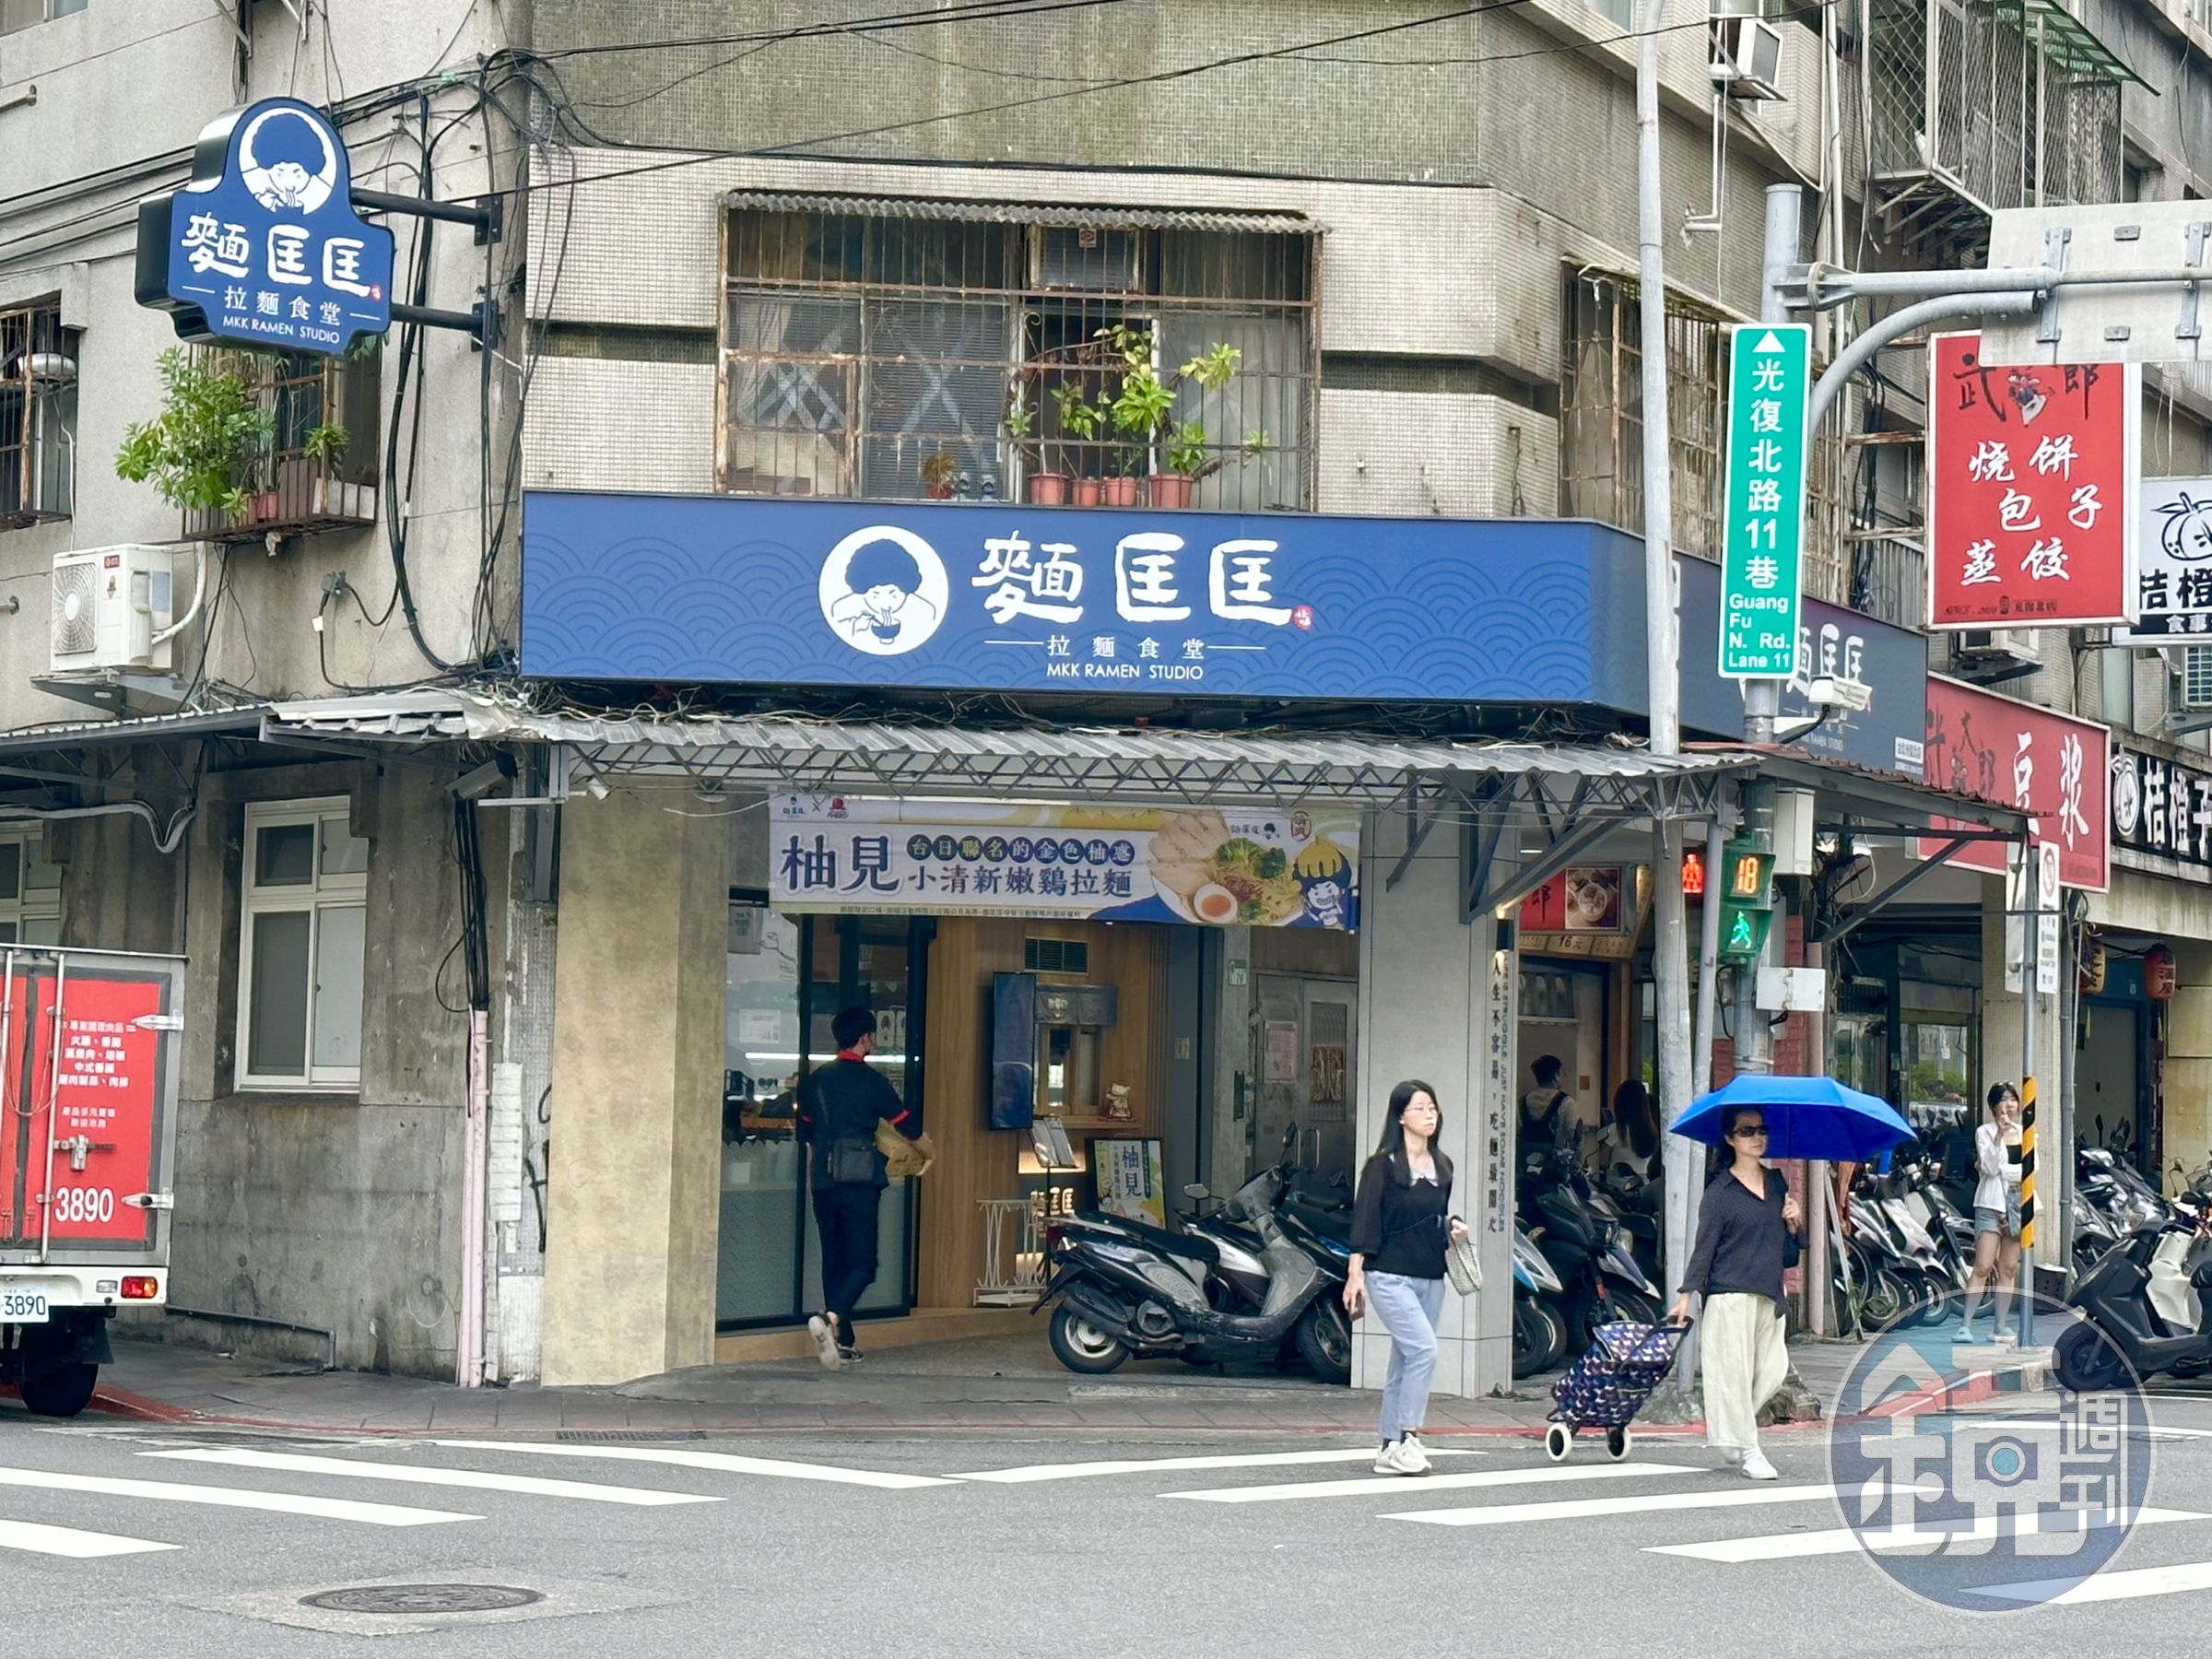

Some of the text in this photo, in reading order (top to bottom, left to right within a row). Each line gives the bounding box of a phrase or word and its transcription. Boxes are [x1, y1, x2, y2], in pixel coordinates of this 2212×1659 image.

[182, 212, 371, 298] 麵匡匡
[224, 285, 341, 326] 拉麵食堂
[222, 314, 340, 345] MKK RAMEN STUDIO
[1745, 358, 1784, 590] 光復北路11巷
[1998, 483, 2102, 532] 包子
[971, 530, 1293, 627] 麵匡匡
[1729, 593, 1789, 614] Guang
[1729, 612, 1752, 629] Fu
[1046, 634, 1205, 660] 拉麵食堂
[1728, 632, 1791, 649] N. Rd.
[1046, 663, 1204, 680] MKK RAMEN STUDIO
[1728, 652, 1790, 668] Lane 11
[780, 834, 900, 891] 柚見
[909, 835, 1133, 864] 台日聯名的金色柚惑
[1736, 856, 1758, 894] 18
[55, 1187, 114, 1223] 3890
